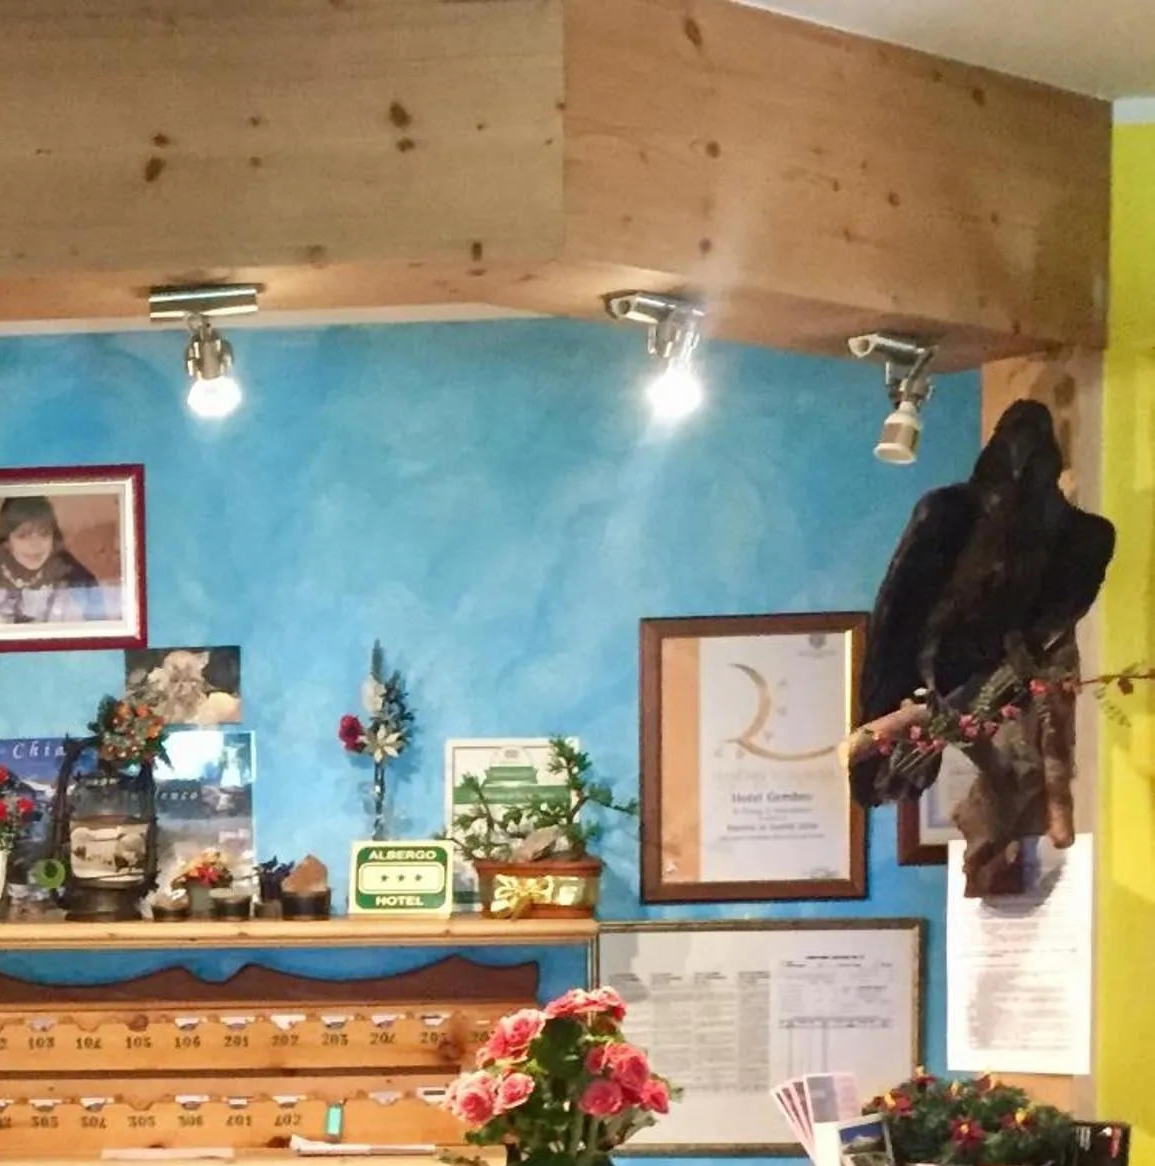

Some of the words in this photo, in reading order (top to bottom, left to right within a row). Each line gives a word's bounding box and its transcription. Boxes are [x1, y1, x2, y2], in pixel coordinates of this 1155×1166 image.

[368, 850, 436, 860] ALBERGO
[375, 896, 424, 907] HOTEL
[28, 1037, 55, 1049] 103
[126, 1037, 151, 1049] 105
[175, 1037, 201, 1048] 106
[224, 1035, 249, 1047] 201
[271, 1035, 299, 1047] 202
[321, 1034, 348, 1046] 203
